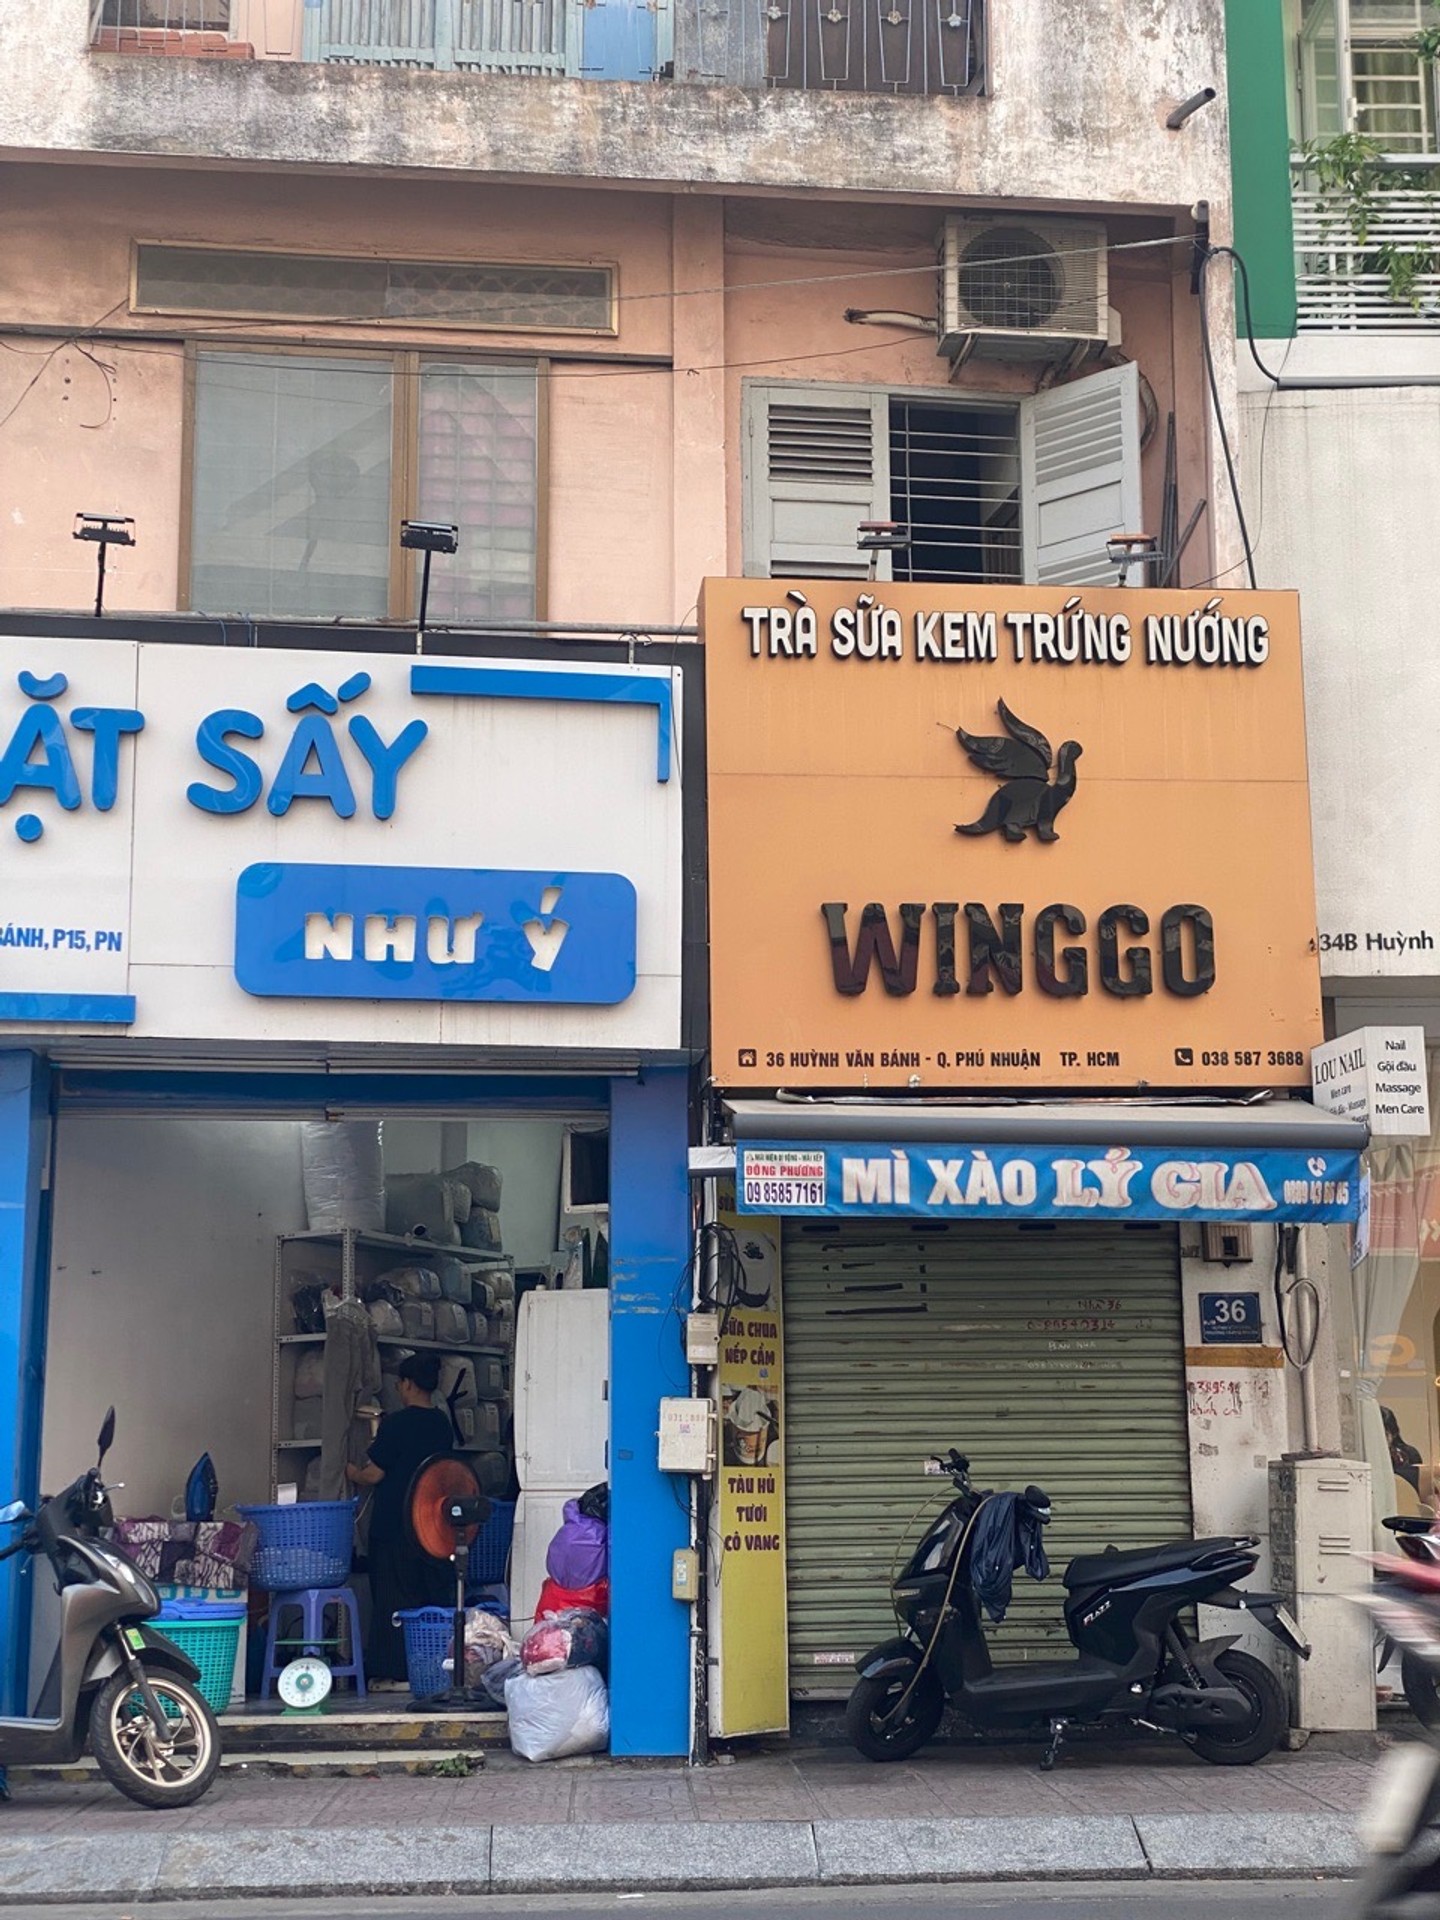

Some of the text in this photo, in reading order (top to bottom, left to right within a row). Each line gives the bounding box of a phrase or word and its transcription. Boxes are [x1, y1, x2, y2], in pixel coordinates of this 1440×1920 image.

[742, 591, 1270, 666] TRÀ SỮA KEM TRỨNG NƯỚNG
[187, 671, 429, 821] SẤY
[53, 929, 91, 951] P15,
[94, 931, 123, 952] PN
[304, 886, 570, 972] NHƯ Ý
[820, 902, 1215, 998] WINGGO
[1319, 930, 1434, 956] 34B Huỳnh
[1385, 1039, 1406, 1050] Nail
[766, 1052, 785, 1068] 36
[790, 1049, 839, 1068] HUỲNH
[846, 1048, 875, 1068] VĂN
[880, 1048, 920, 1068] BÁNH
[937, 1051, 951, 1069] Q.
[955, 1048, 985, 1068] PHÚ
[990, 1048, 1040, 1071] NHUẬN
[1060, 1051, 1081, 1067] TP.
[1087, 1051, 1120, 1067] HCM
[1201, 1051, 1304, 1066] 038 587 3688
[1314, 1047, 1366, 1086] LOU NAIL
[1375, 1082, 1422, 1096] Massage
[1375, 1103, 1425, 1115] Men Care
[842, 1149, 911, 1205] MÌ
[926, 1150, 1037, 1206] XÀO
[1151, 1161, 1277, 1210] GIA
[747, 1182, 823, 1204] 09 8585 7161
[1215, 1299, 1246, 1323] 36
[747, 1321, 777, 1339] CHUA
[736, 1503, 767, 1522] TƯƠI
[745, 1534, 780, 1551] VANG
